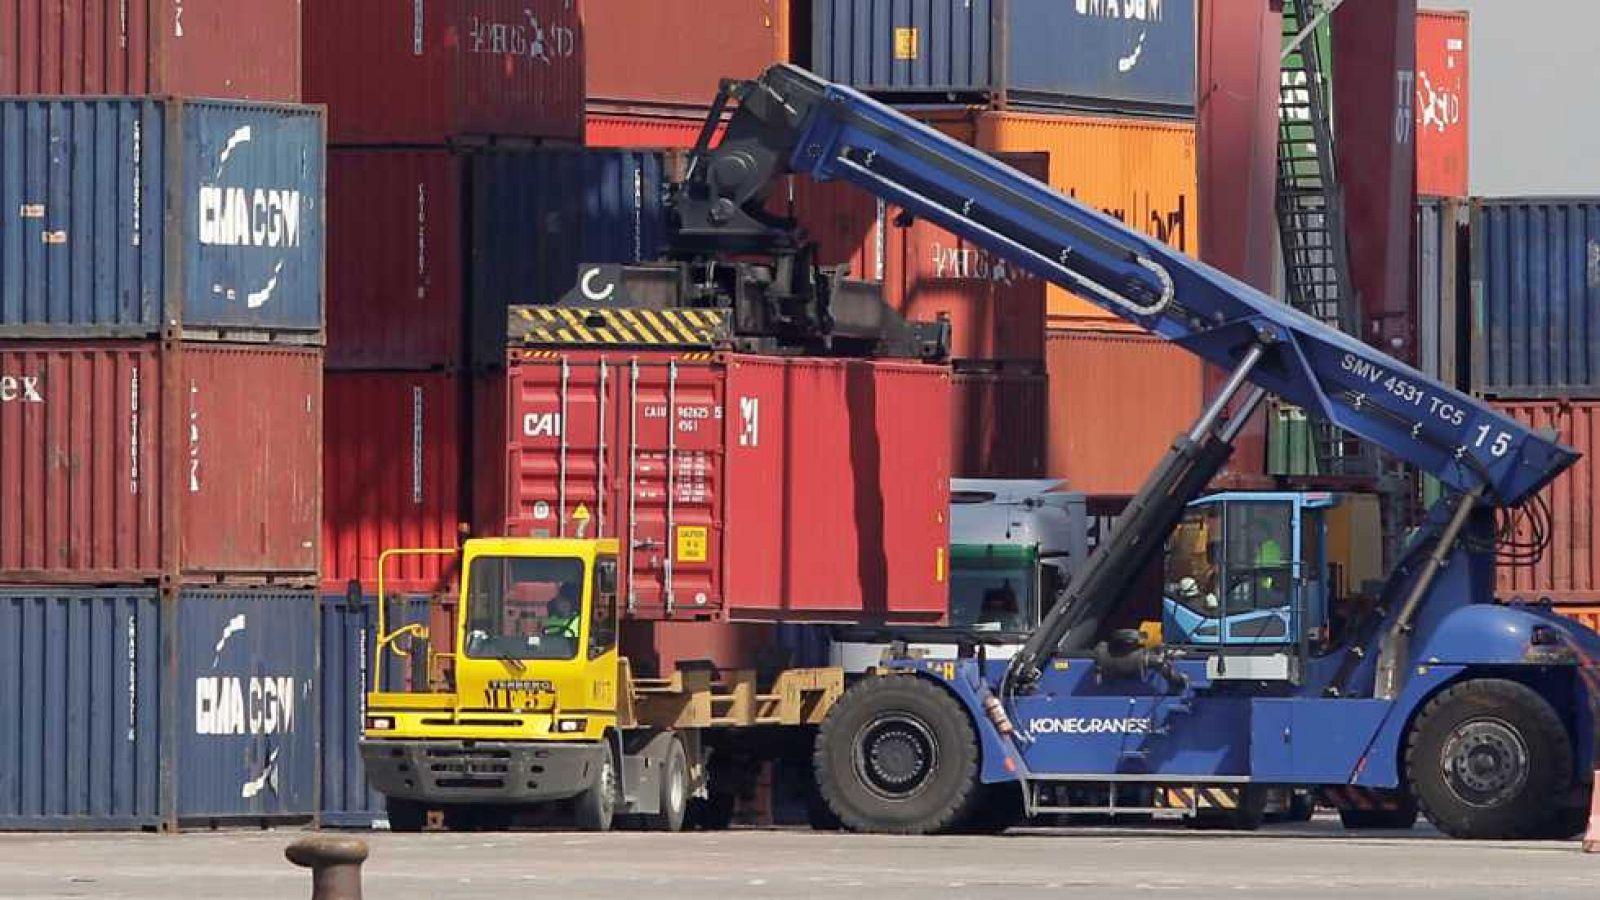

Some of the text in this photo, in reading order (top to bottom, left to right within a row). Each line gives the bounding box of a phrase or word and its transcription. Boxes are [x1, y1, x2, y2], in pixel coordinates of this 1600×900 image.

[252, 187, 300, 248] CGM
[1341, 353, 1384, 384] SMV
[1383, 376, 1425, 406] 4531
[1428, 395, 1467, 427] TC5
[523, 411, 562, 438] CAI
[249, 676, 296, 735] CGM
[1029, 717, 1150, 734] KONECRANES
